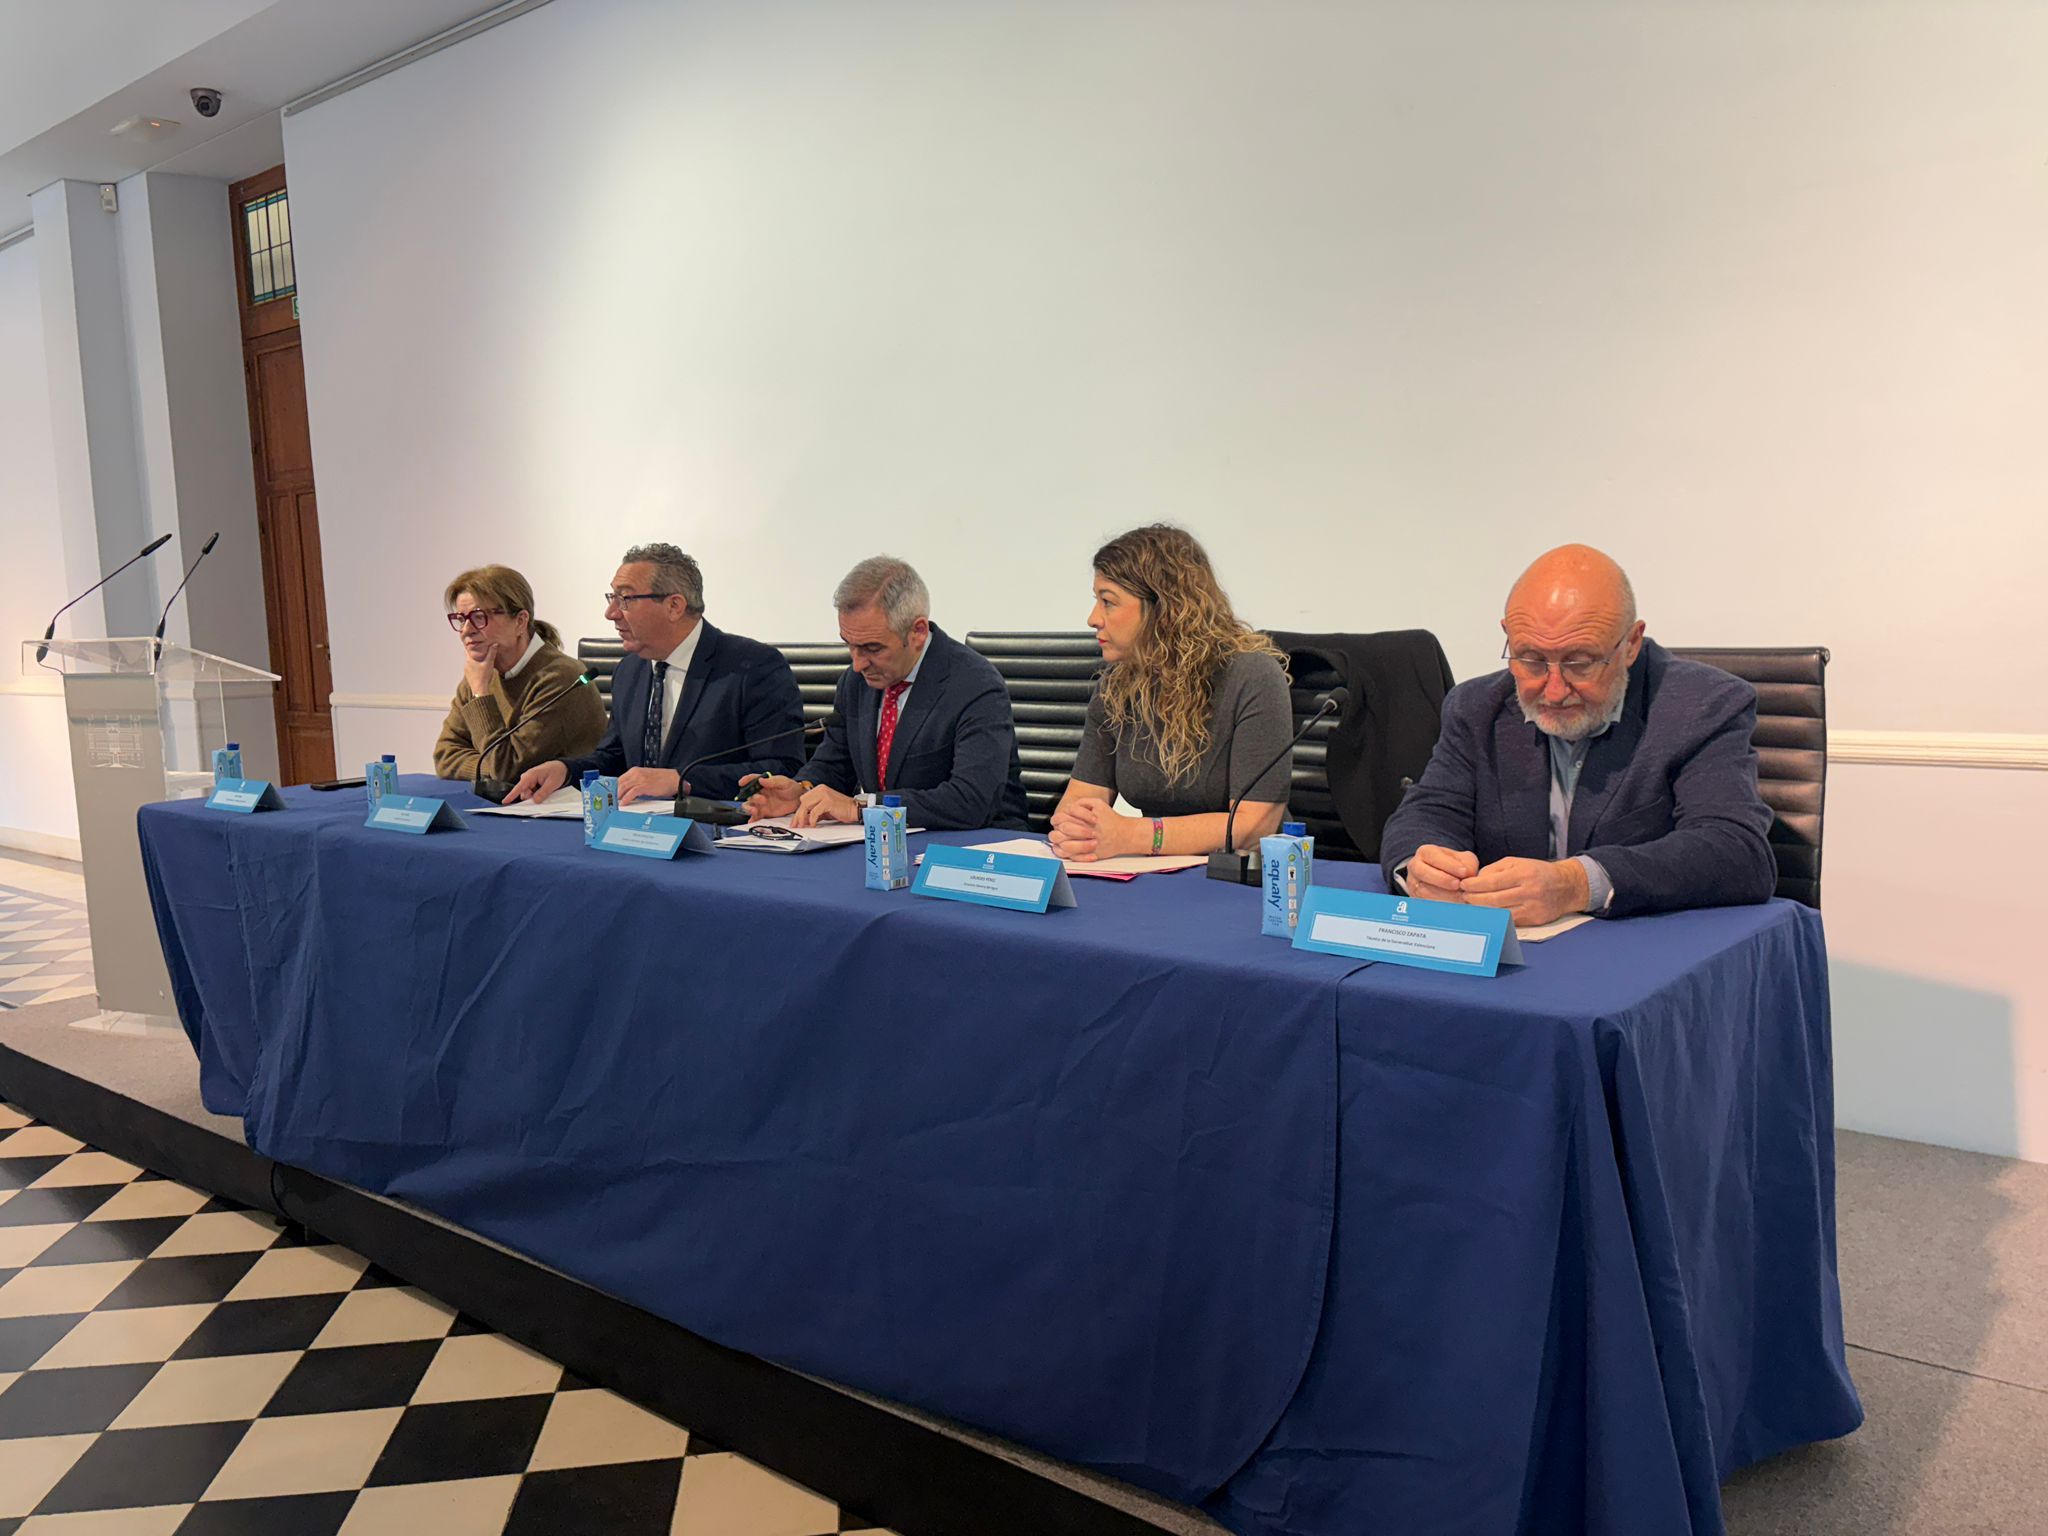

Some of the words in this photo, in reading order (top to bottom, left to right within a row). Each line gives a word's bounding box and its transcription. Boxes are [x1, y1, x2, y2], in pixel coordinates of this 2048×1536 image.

[867, 825, 878, 868] aqualy
[1267, 859, 1282, 911] aqualy
[1378, 927, 1407, 936] FRANCISCO
[1407, 931, 1427, 939] ZAPATA
